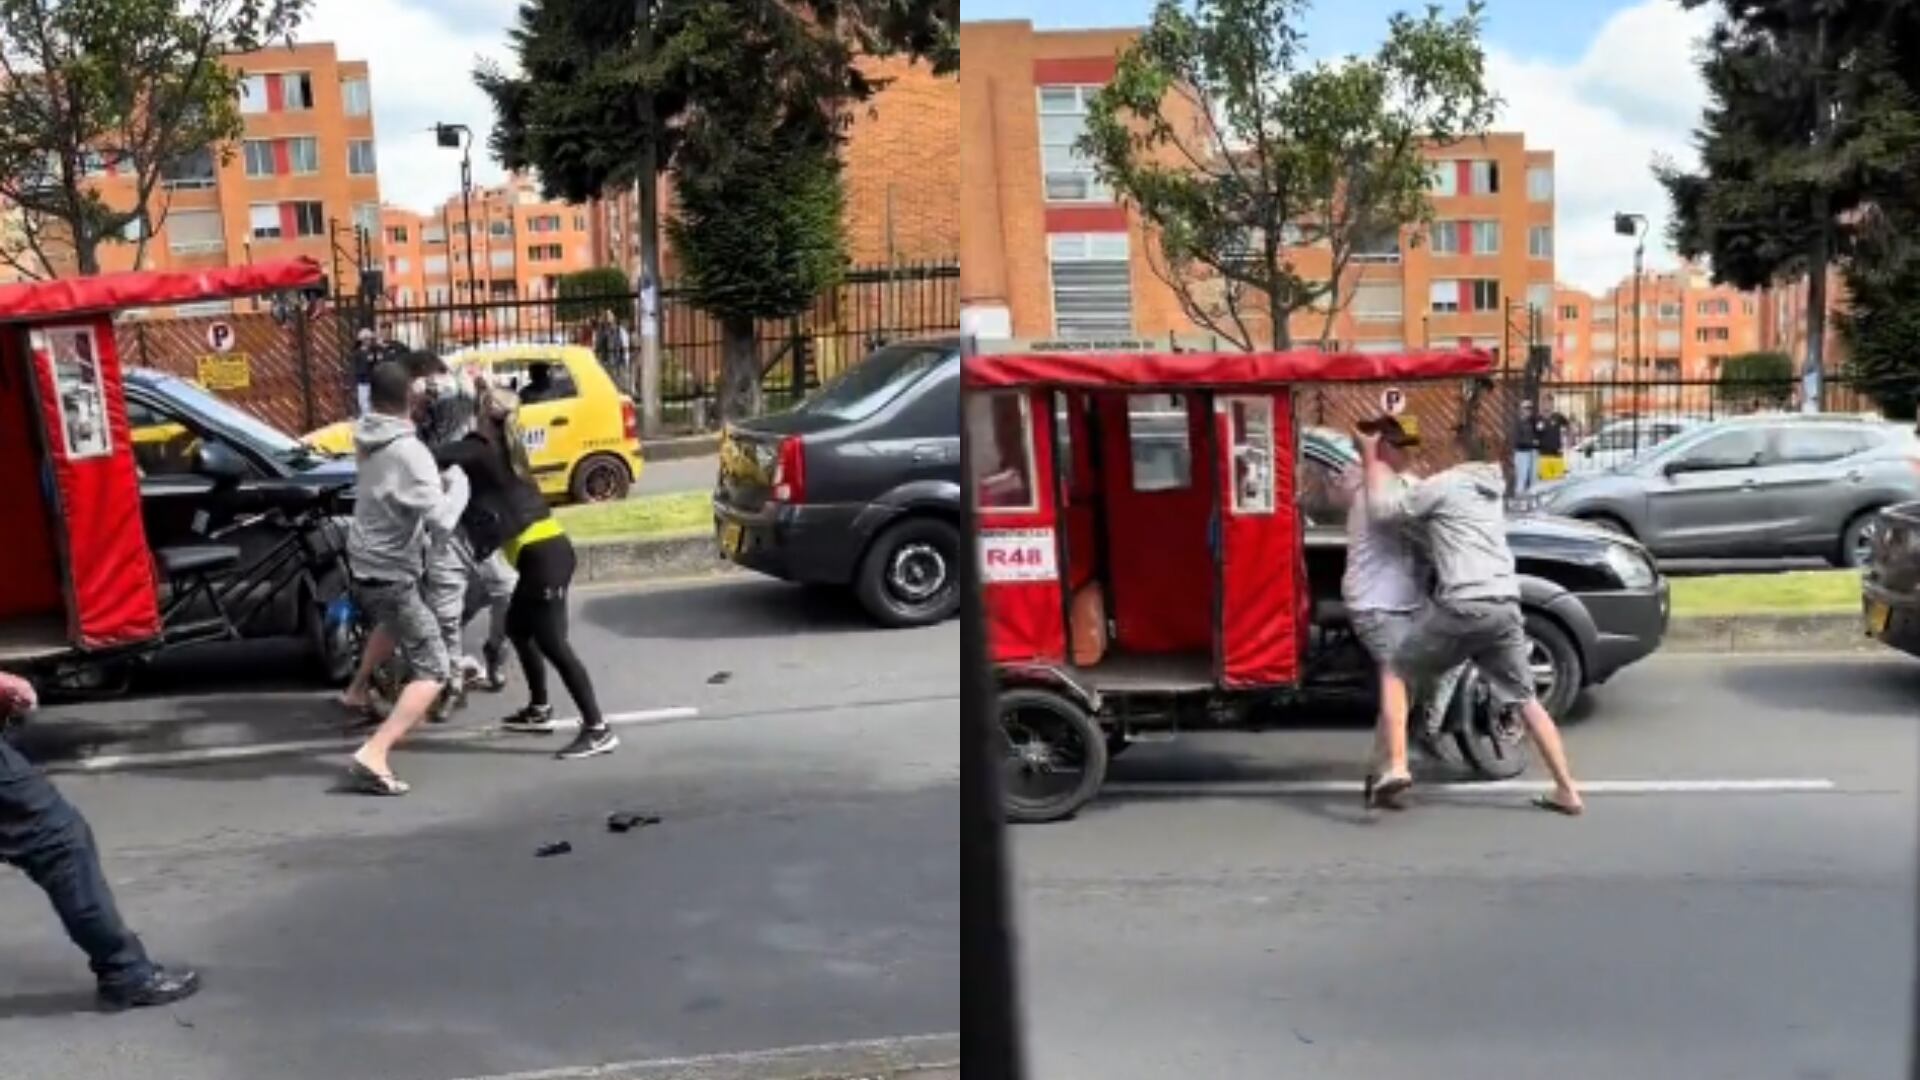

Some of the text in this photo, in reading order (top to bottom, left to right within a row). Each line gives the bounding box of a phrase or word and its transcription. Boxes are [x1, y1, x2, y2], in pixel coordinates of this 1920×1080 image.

[212, 325, 229, 347] P
[1386, 391, 1400, 411] P
[986, 548, 1042, 566] R48
